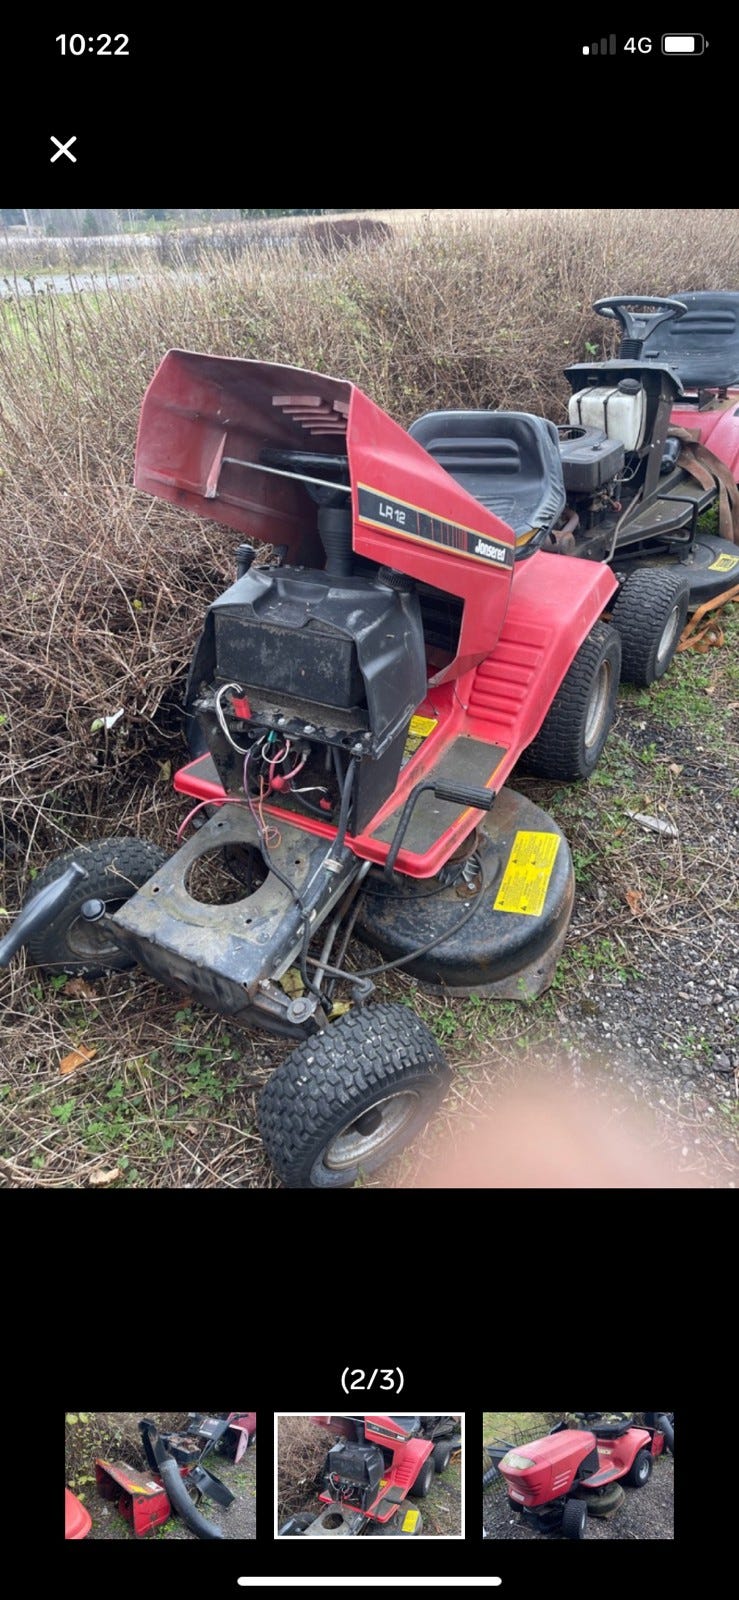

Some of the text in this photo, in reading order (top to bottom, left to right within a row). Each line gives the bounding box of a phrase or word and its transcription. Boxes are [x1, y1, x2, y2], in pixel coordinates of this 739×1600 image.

[379, 503, 406, 525] LR 12
[475, 539, 506, 561] Jonsered
